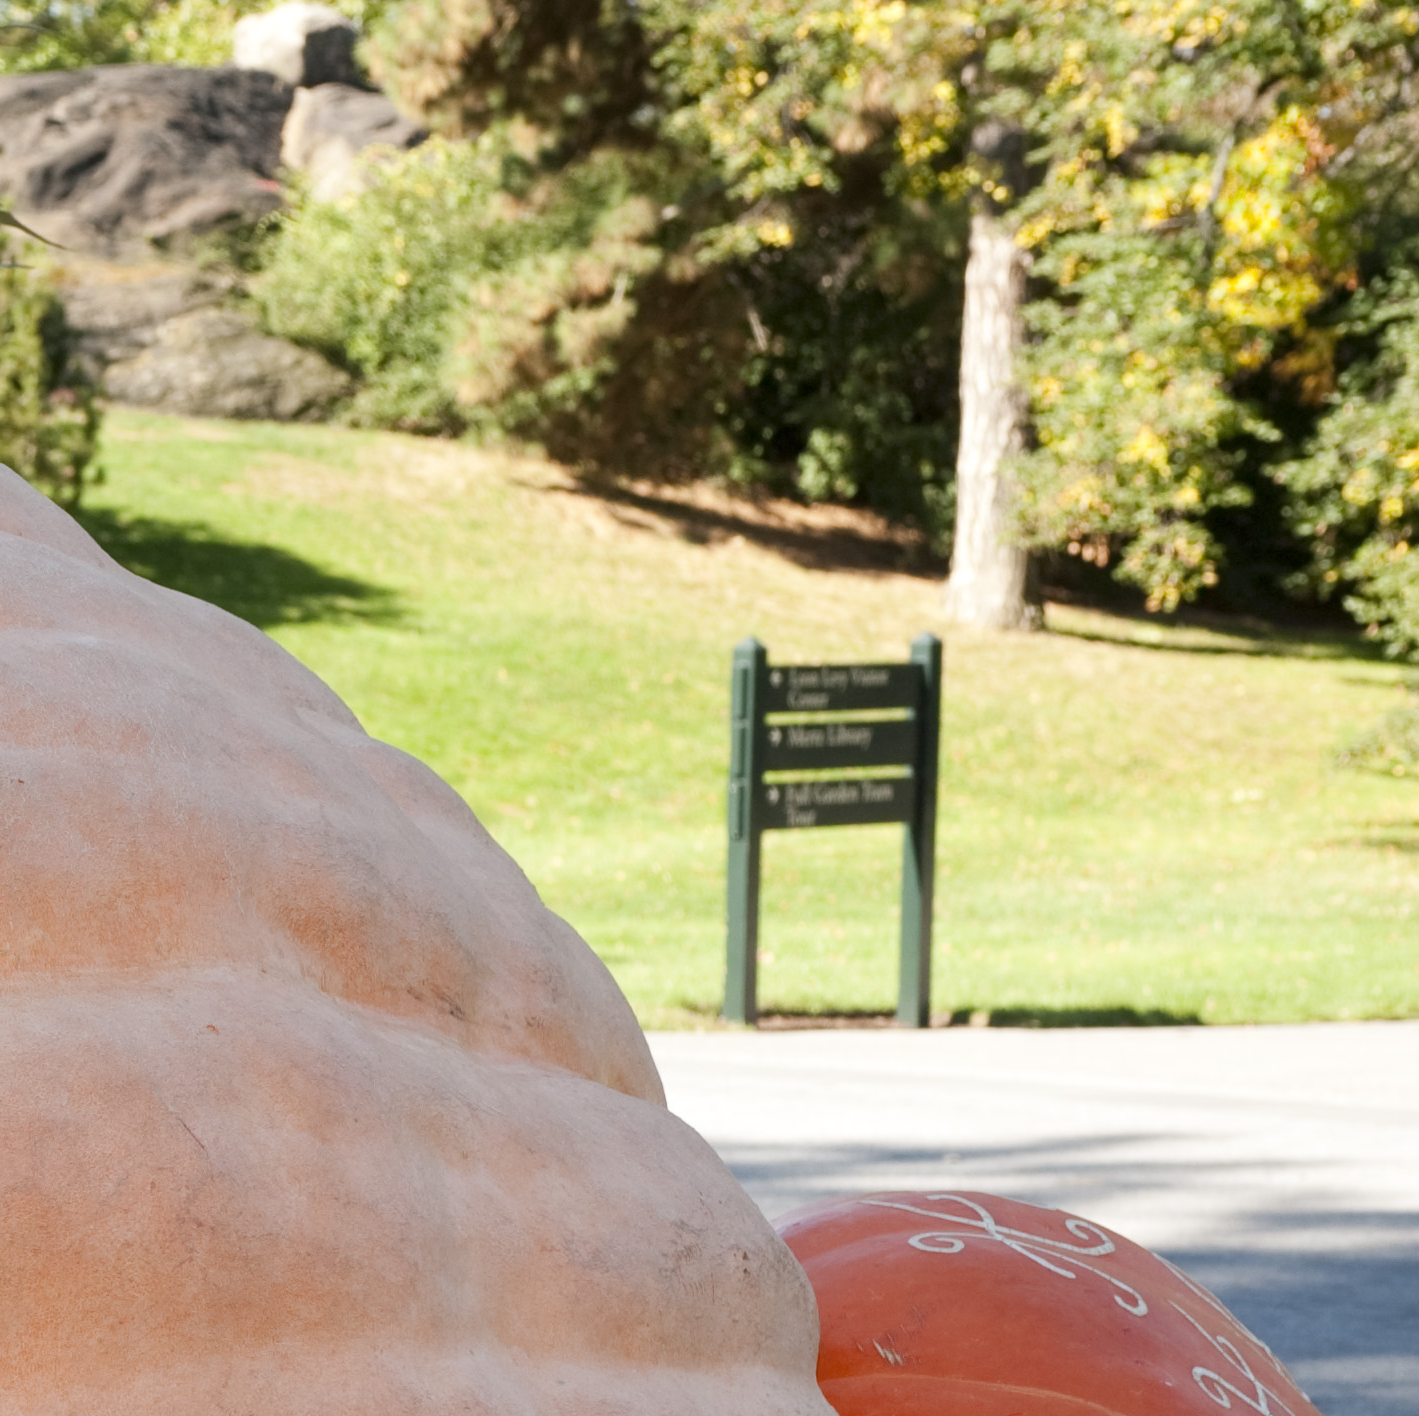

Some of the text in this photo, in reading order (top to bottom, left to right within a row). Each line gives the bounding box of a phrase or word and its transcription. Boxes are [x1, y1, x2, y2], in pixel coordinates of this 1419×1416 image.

[850, 665, 890, 687] Visitor
[786, 688, 829, 709] Center
[826, 723, 873, 751] Library
[813, 783, 859, 805] Garden
